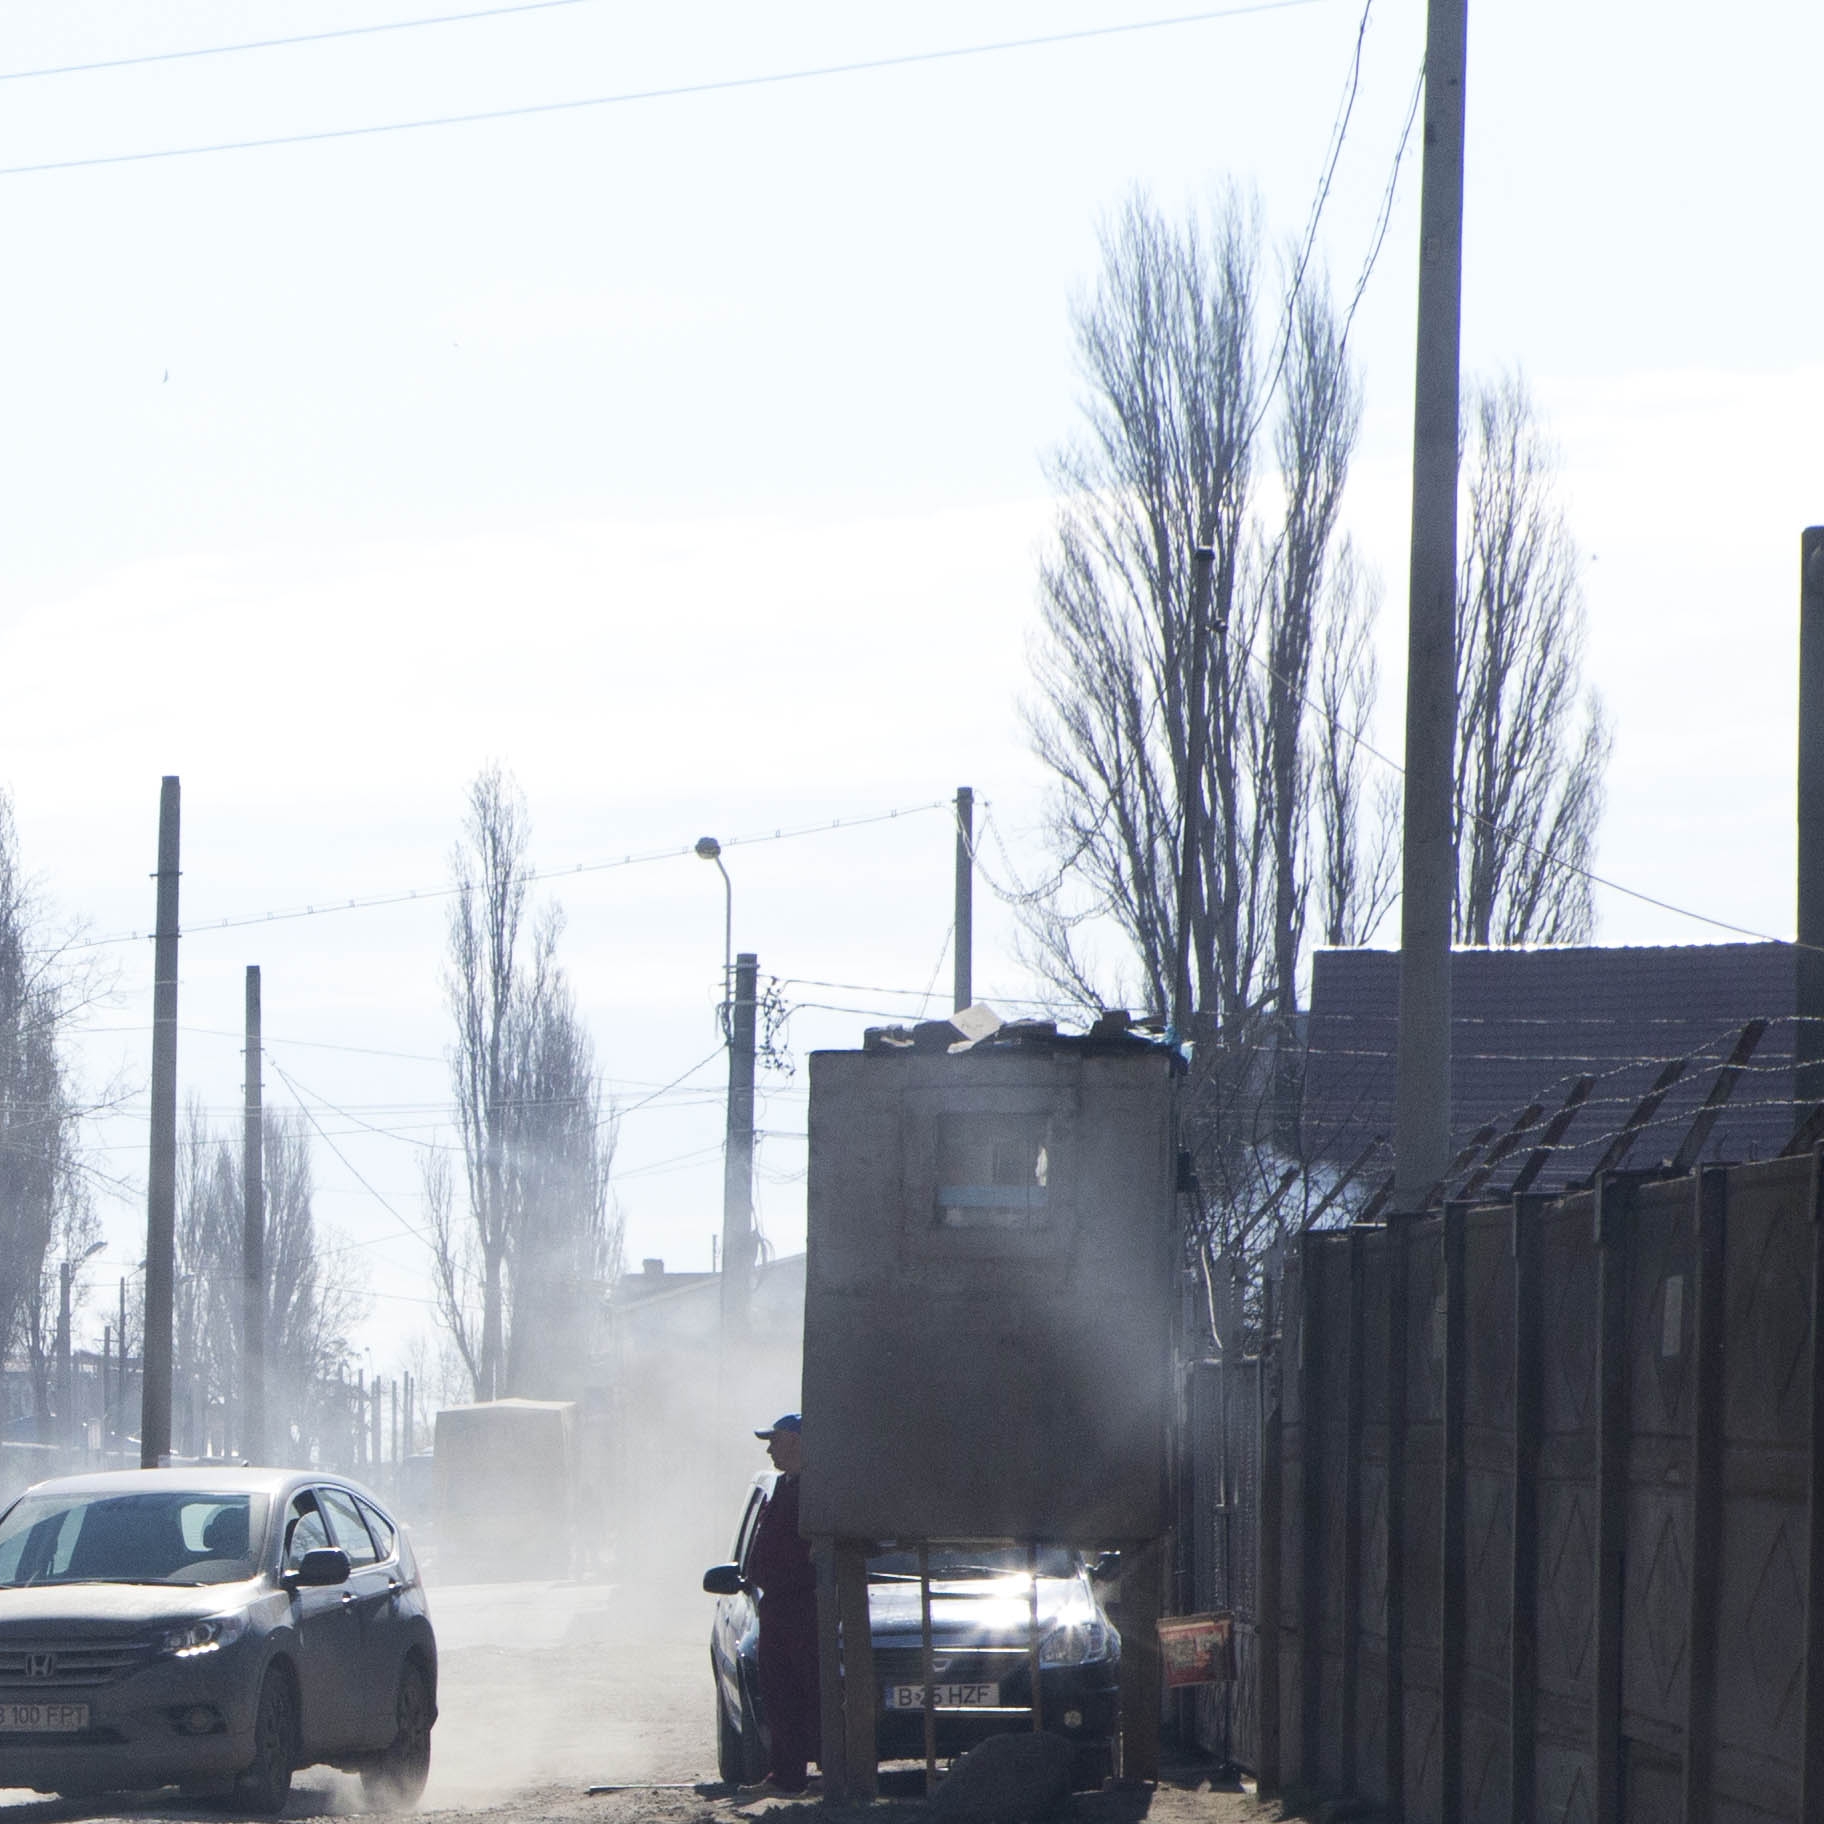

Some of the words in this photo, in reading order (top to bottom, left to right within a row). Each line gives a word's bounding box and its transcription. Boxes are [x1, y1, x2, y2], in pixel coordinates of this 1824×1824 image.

[898, 1687, 912, 1706] B
[949, 1685, 991, 1704] HZF
[12, 1705, 40, 1724] 100
